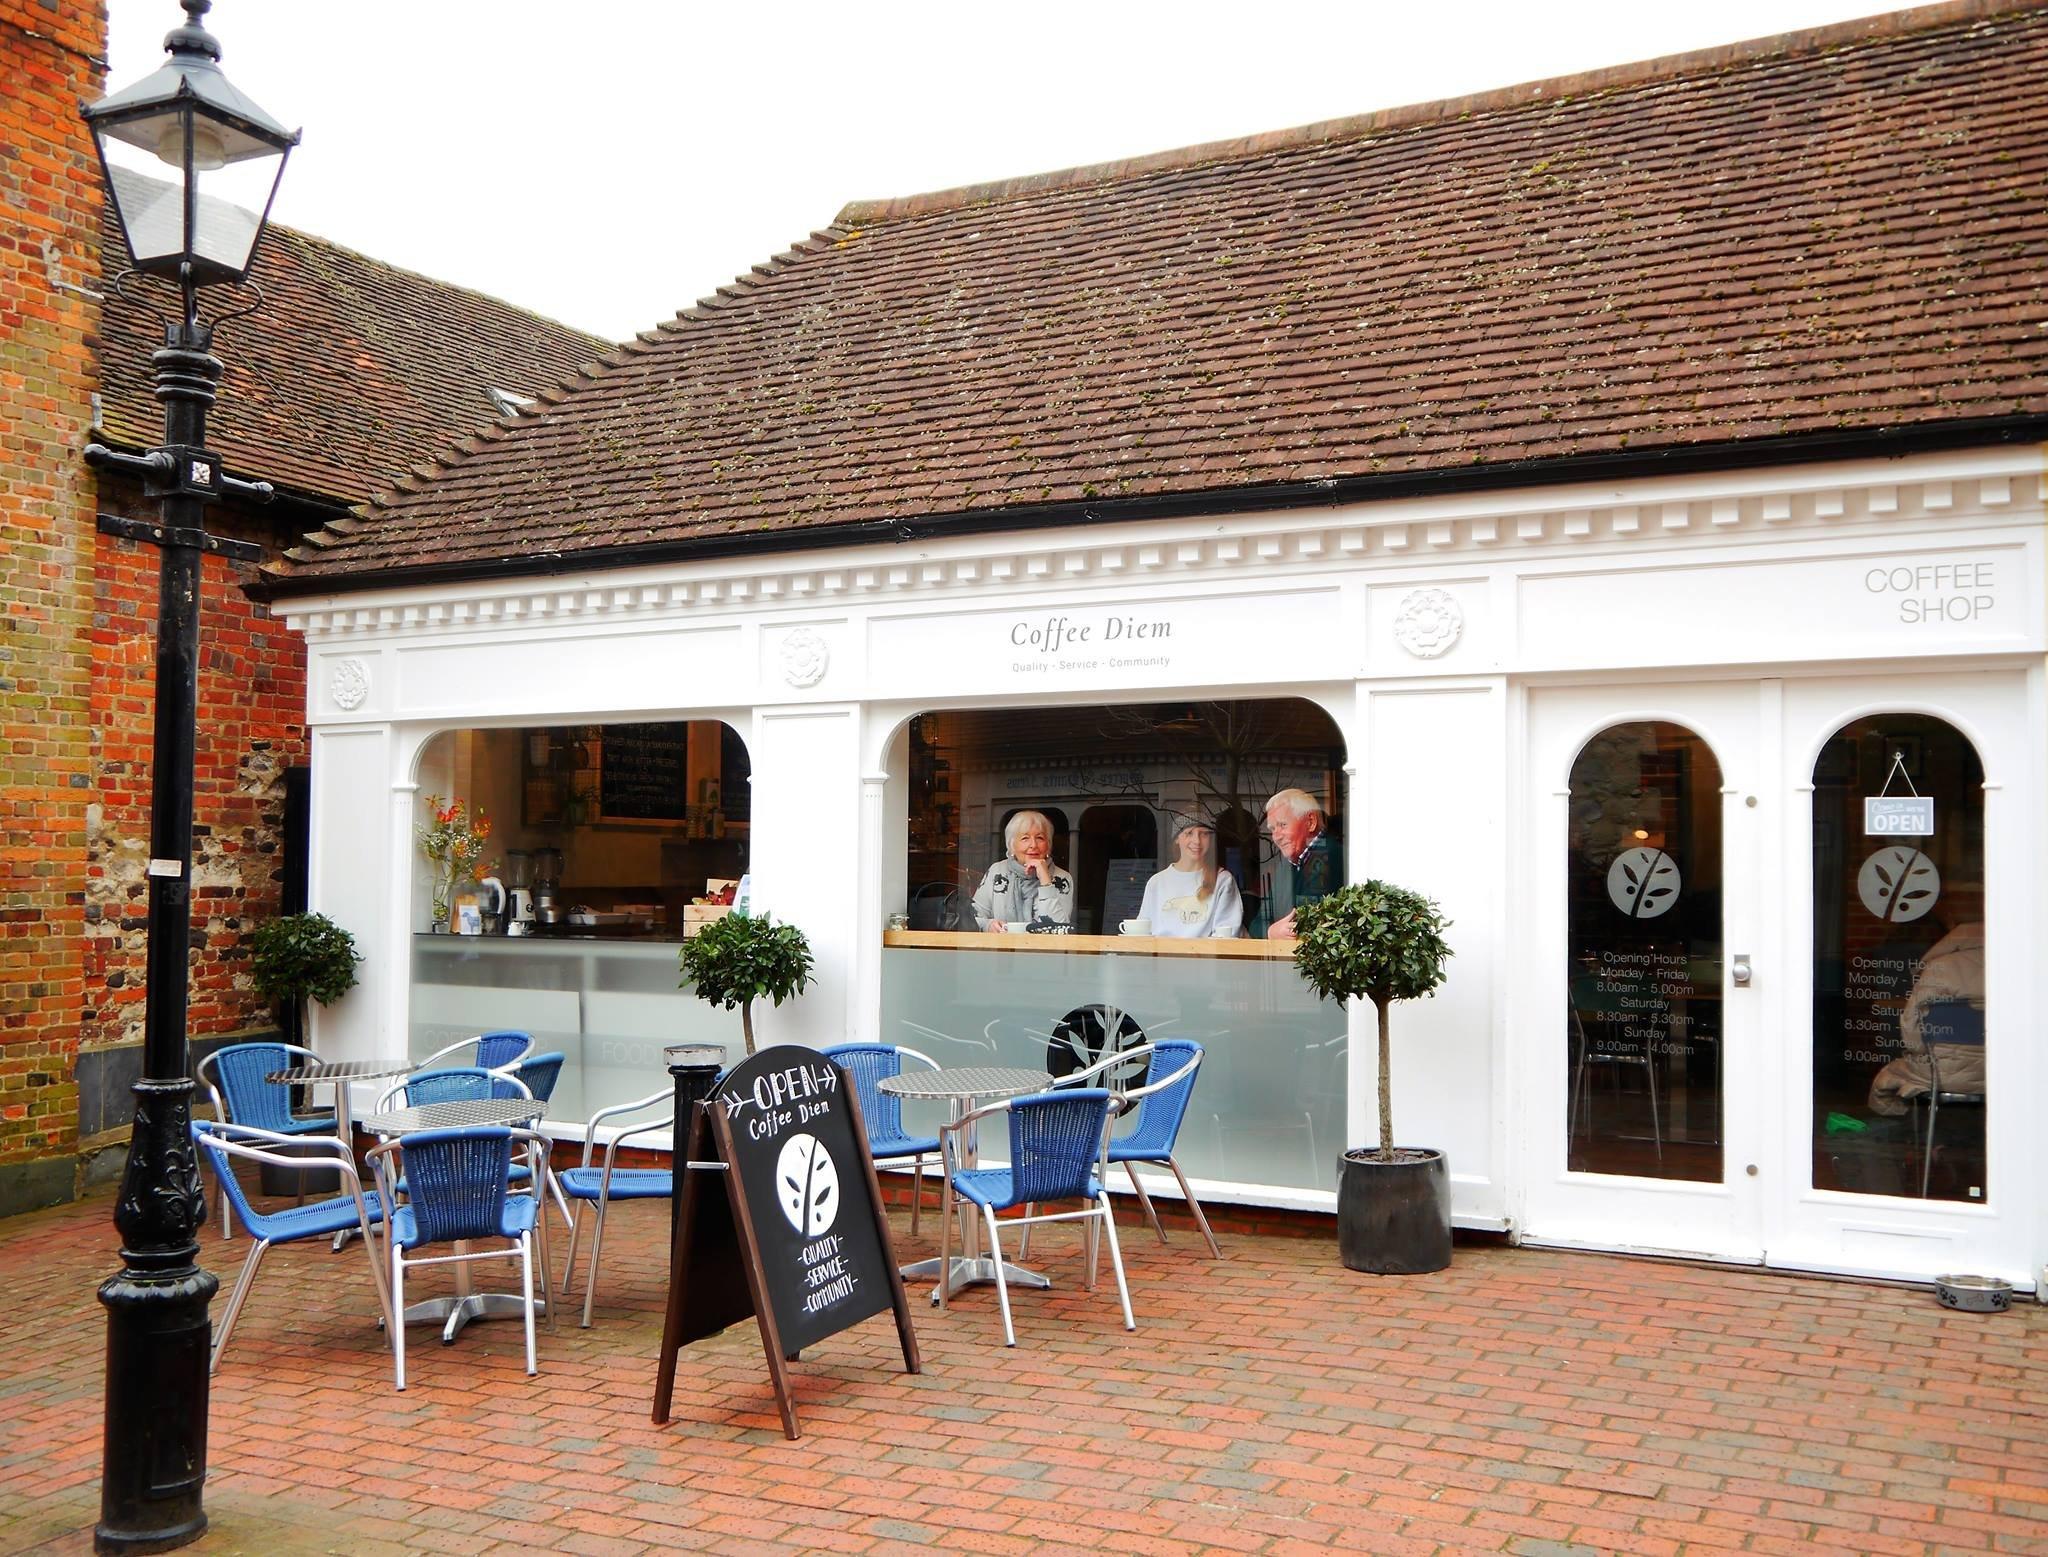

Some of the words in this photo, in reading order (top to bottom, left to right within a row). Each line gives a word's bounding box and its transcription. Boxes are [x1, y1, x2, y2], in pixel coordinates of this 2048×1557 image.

[1865, 562, 1994, 593] COFFEE
[1900, 595, 1994, 623] SHOP
[1011, 617, 1091, 652] Coffee
[1104, 617, 1172, 640] Diem
[1012, 662, 1048, 673] Quality
[1059, 660, 1098, 670] Service
[1109, 656, 1170, 668] Community
[1874, 814, 1925, 831] OPEN
[1603, 951, 1650, 966] Opening
[1653, 953, 1688, 964] Hours
[1852, 956, 1904, 971] Opening
[1600, 967, 1645, 980] Monday
[1656, 968, 1690, 982] Friday
[1848, 972, 1898, 987] Monday
[1597, 981, 1639, 992] 8.00am
[1650, 983, 1694, 996] 5.00pm
[1844, 988, 1891, 1000] 8.00am
[1620, 997, 1670, 1010] Saturday
[1597, 1011, 1639, 1022] 8.30am
[1650, 1013, 1694, 1025] 5.30pm
[1844, 1019, 1891, 1031] 8.30am
[1624, 1026, 1666, 1040] Sunday
[1597, 1040, 1639, 1051] 9.00am
[1651, 1043, 1694, 1055] 4.00pm
[1844, 1050, 1891, 1063] 9.00am
[753, 1063, 820, 1110] OPEN
[749, 1110, 792, 1140] Coffee
[798, 1100, 830, 1124] Diem
